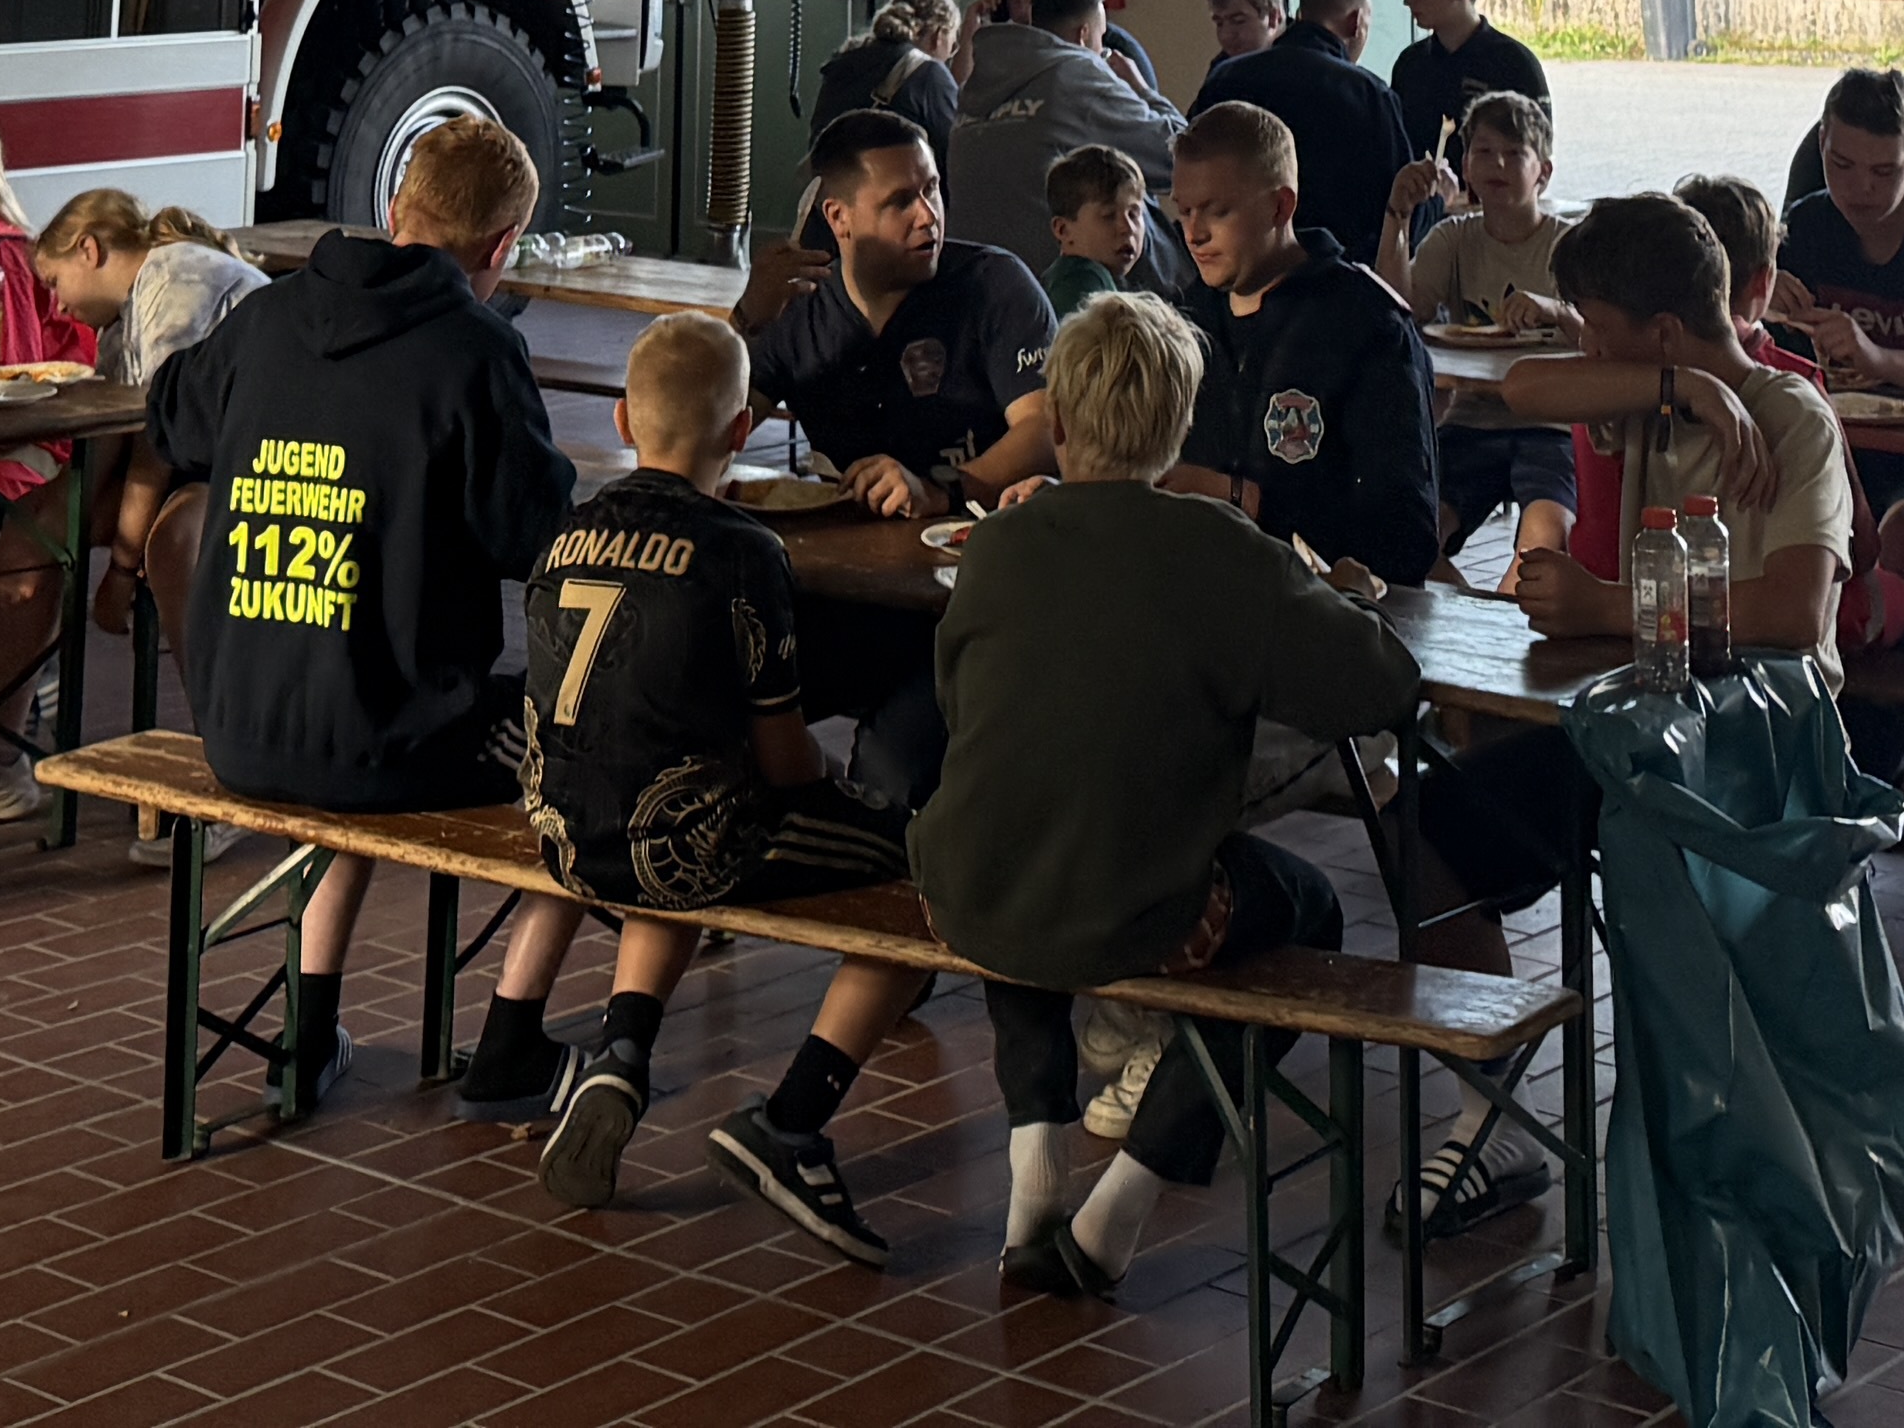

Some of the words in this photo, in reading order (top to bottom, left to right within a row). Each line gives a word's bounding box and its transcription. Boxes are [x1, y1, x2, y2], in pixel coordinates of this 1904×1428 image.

[252, 438, 346, 481] JUGEND
[229, 476, 367, 524] FEUERWEHR
[228, 520, 361, 589] 112%
[545, 527, 695, 577] RONALDO
[228, 575, 358, 632] ZUKUNFT
[553, 577, 628, 727] 7
